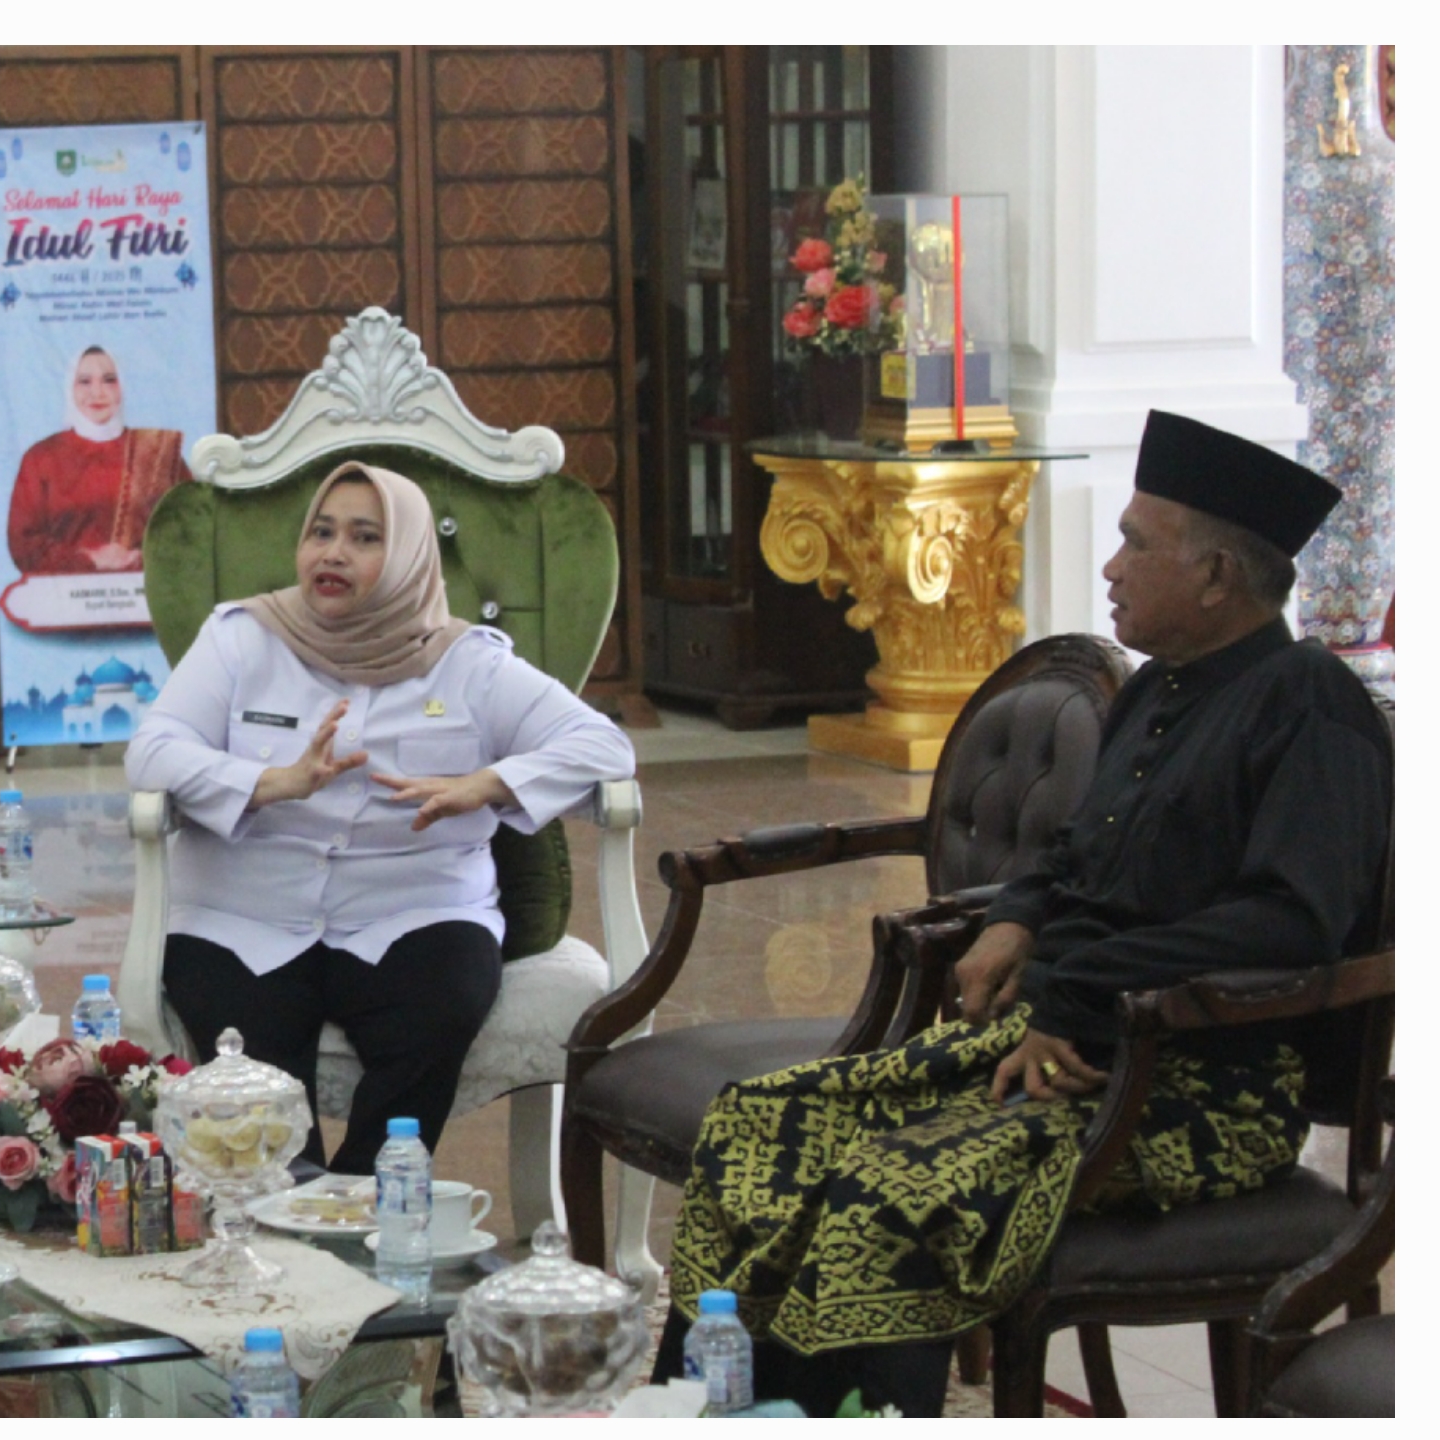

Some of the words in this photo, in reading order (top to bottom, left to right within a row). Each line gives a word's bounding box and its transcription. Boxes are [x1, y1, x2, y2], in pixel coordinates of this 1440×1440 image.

[3, 188, 81, 212] Selamat
[88, 185, 128, 210] Hari
[134, 183, 182, 216] Raya
[2, 217, 94, 267] Idul
[100, 213, 189, 261] Fitri
